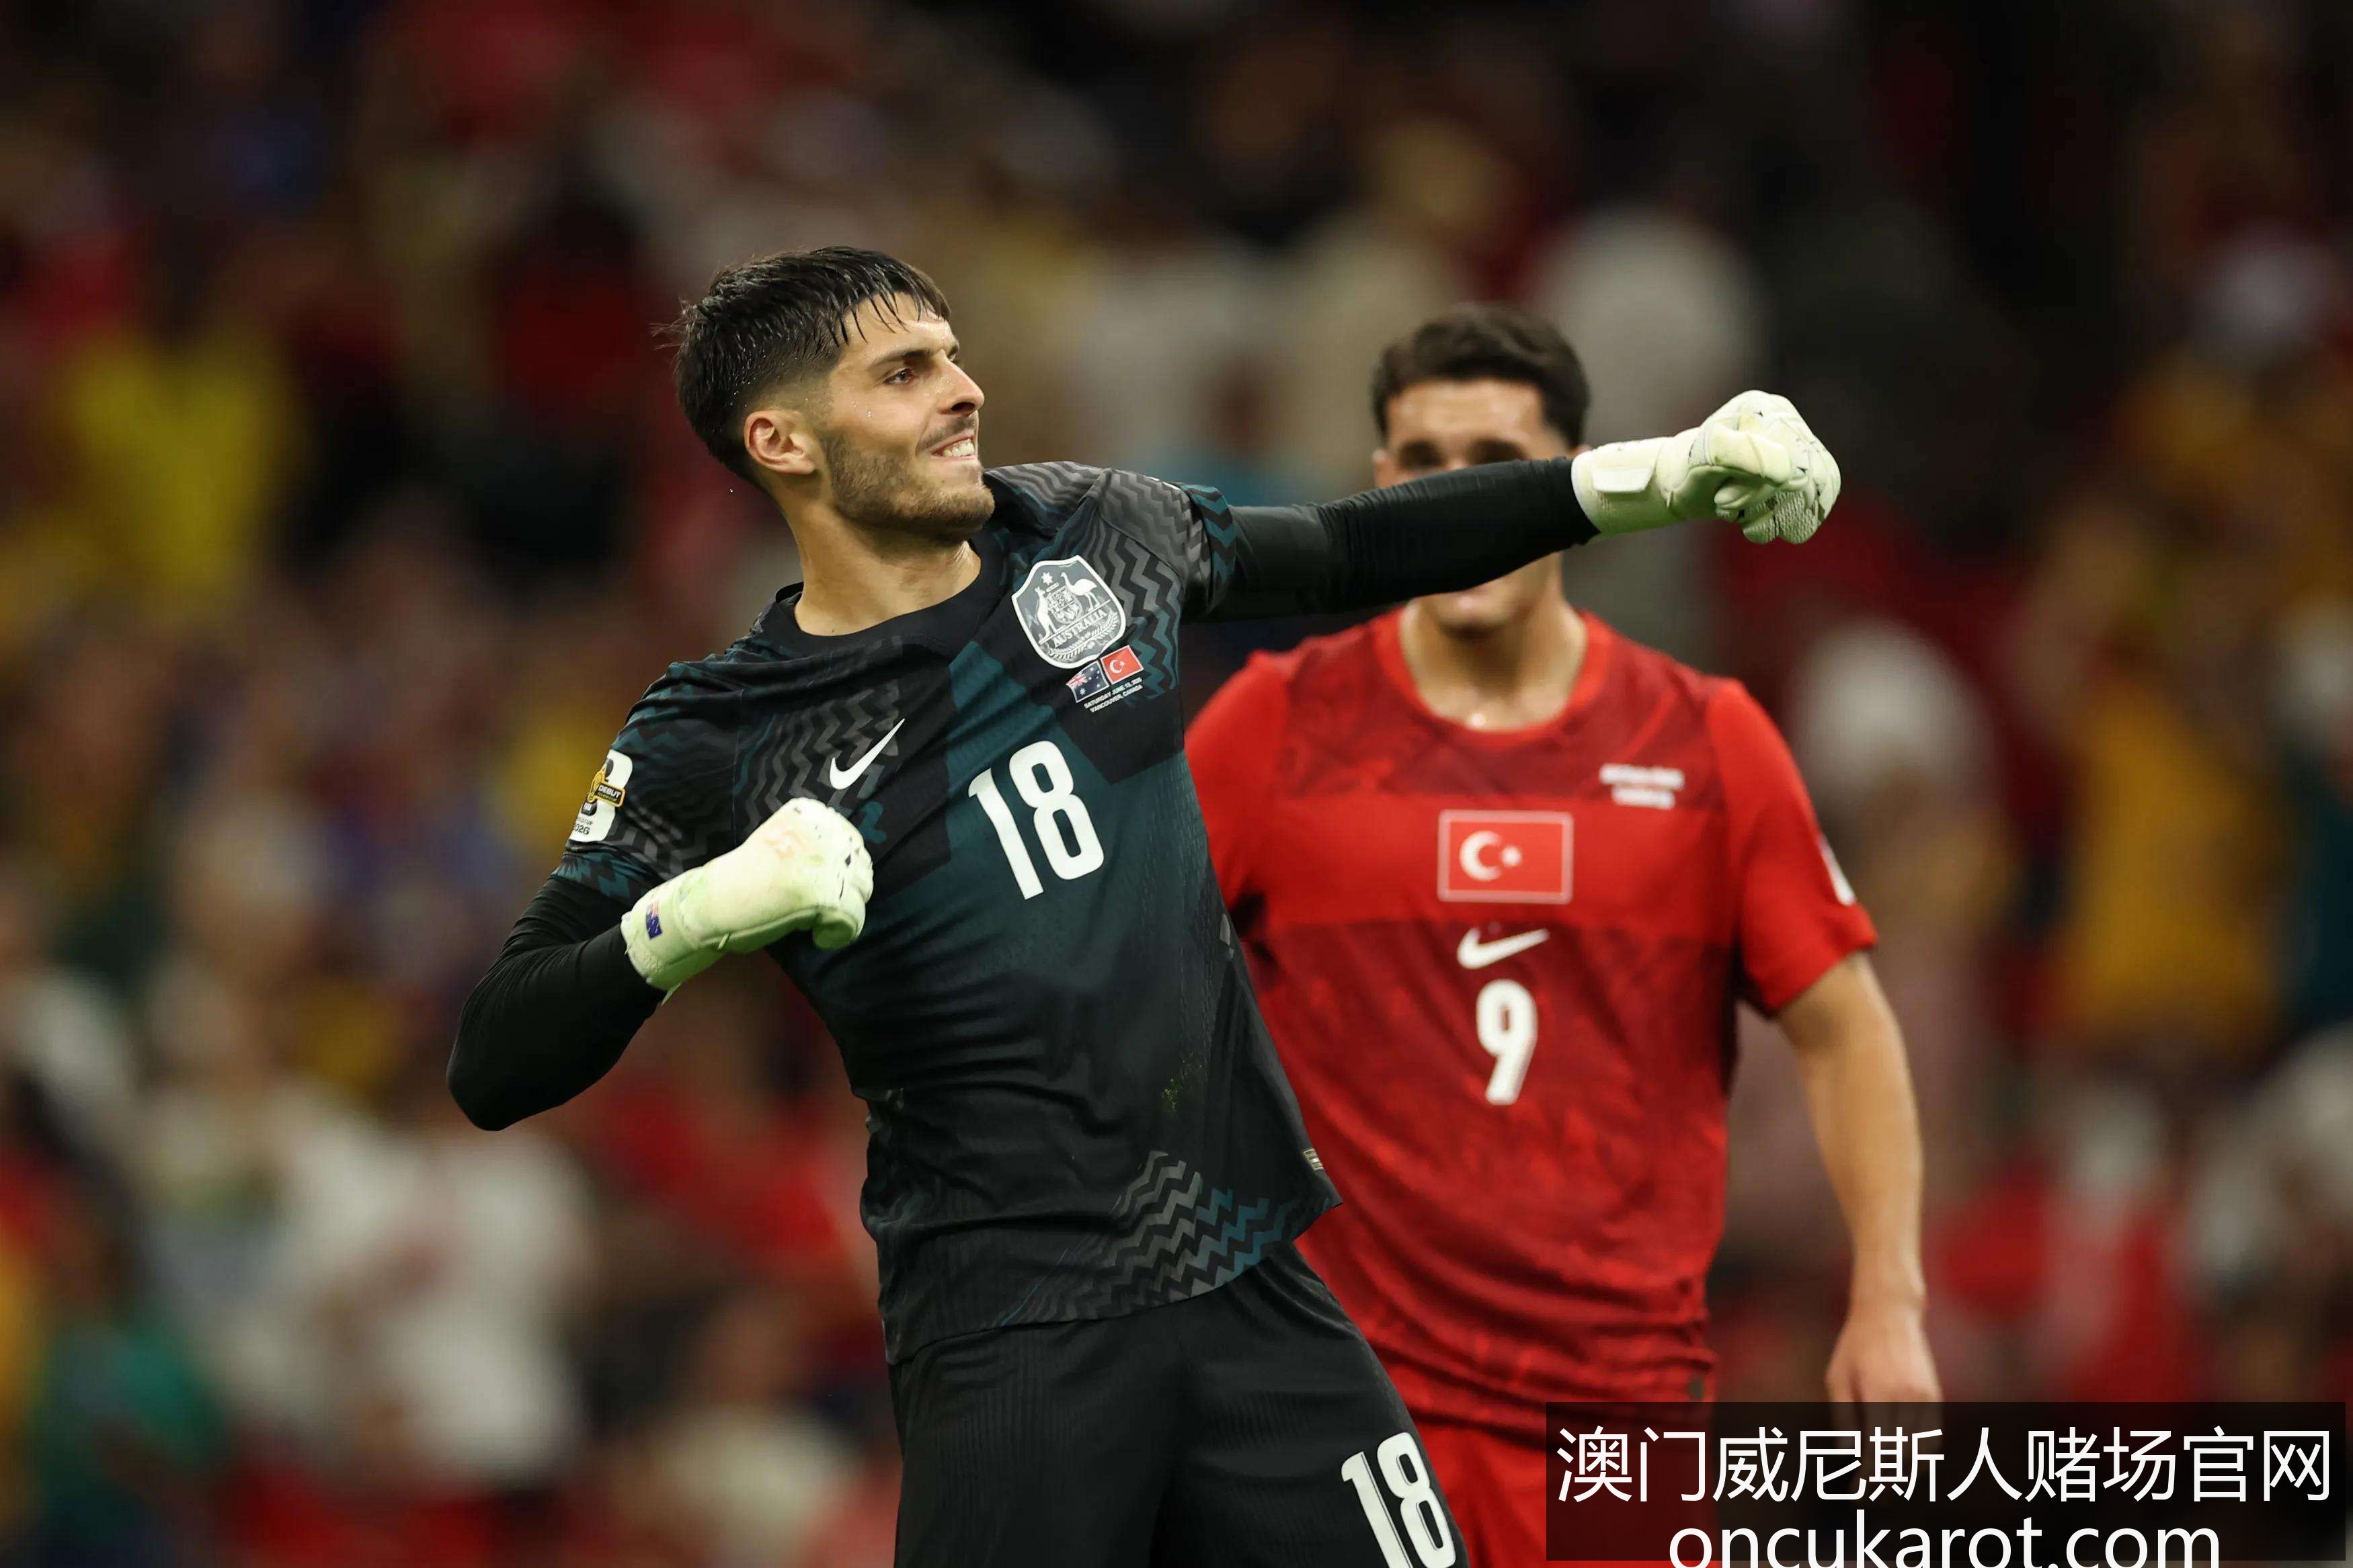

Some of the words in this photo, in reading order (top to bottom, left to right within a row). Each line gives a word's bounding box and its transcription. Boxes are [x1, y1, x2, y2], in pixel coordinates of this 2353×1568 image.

[1053, 609, 1108, 647] AUSTRALIA
[598, 784, 621, 798] DEBUT
[968, 740, 1105, 901] 18
[1476, 979, 1538, 1105] 9
[1341, 1432, 1456, 1568] 18
